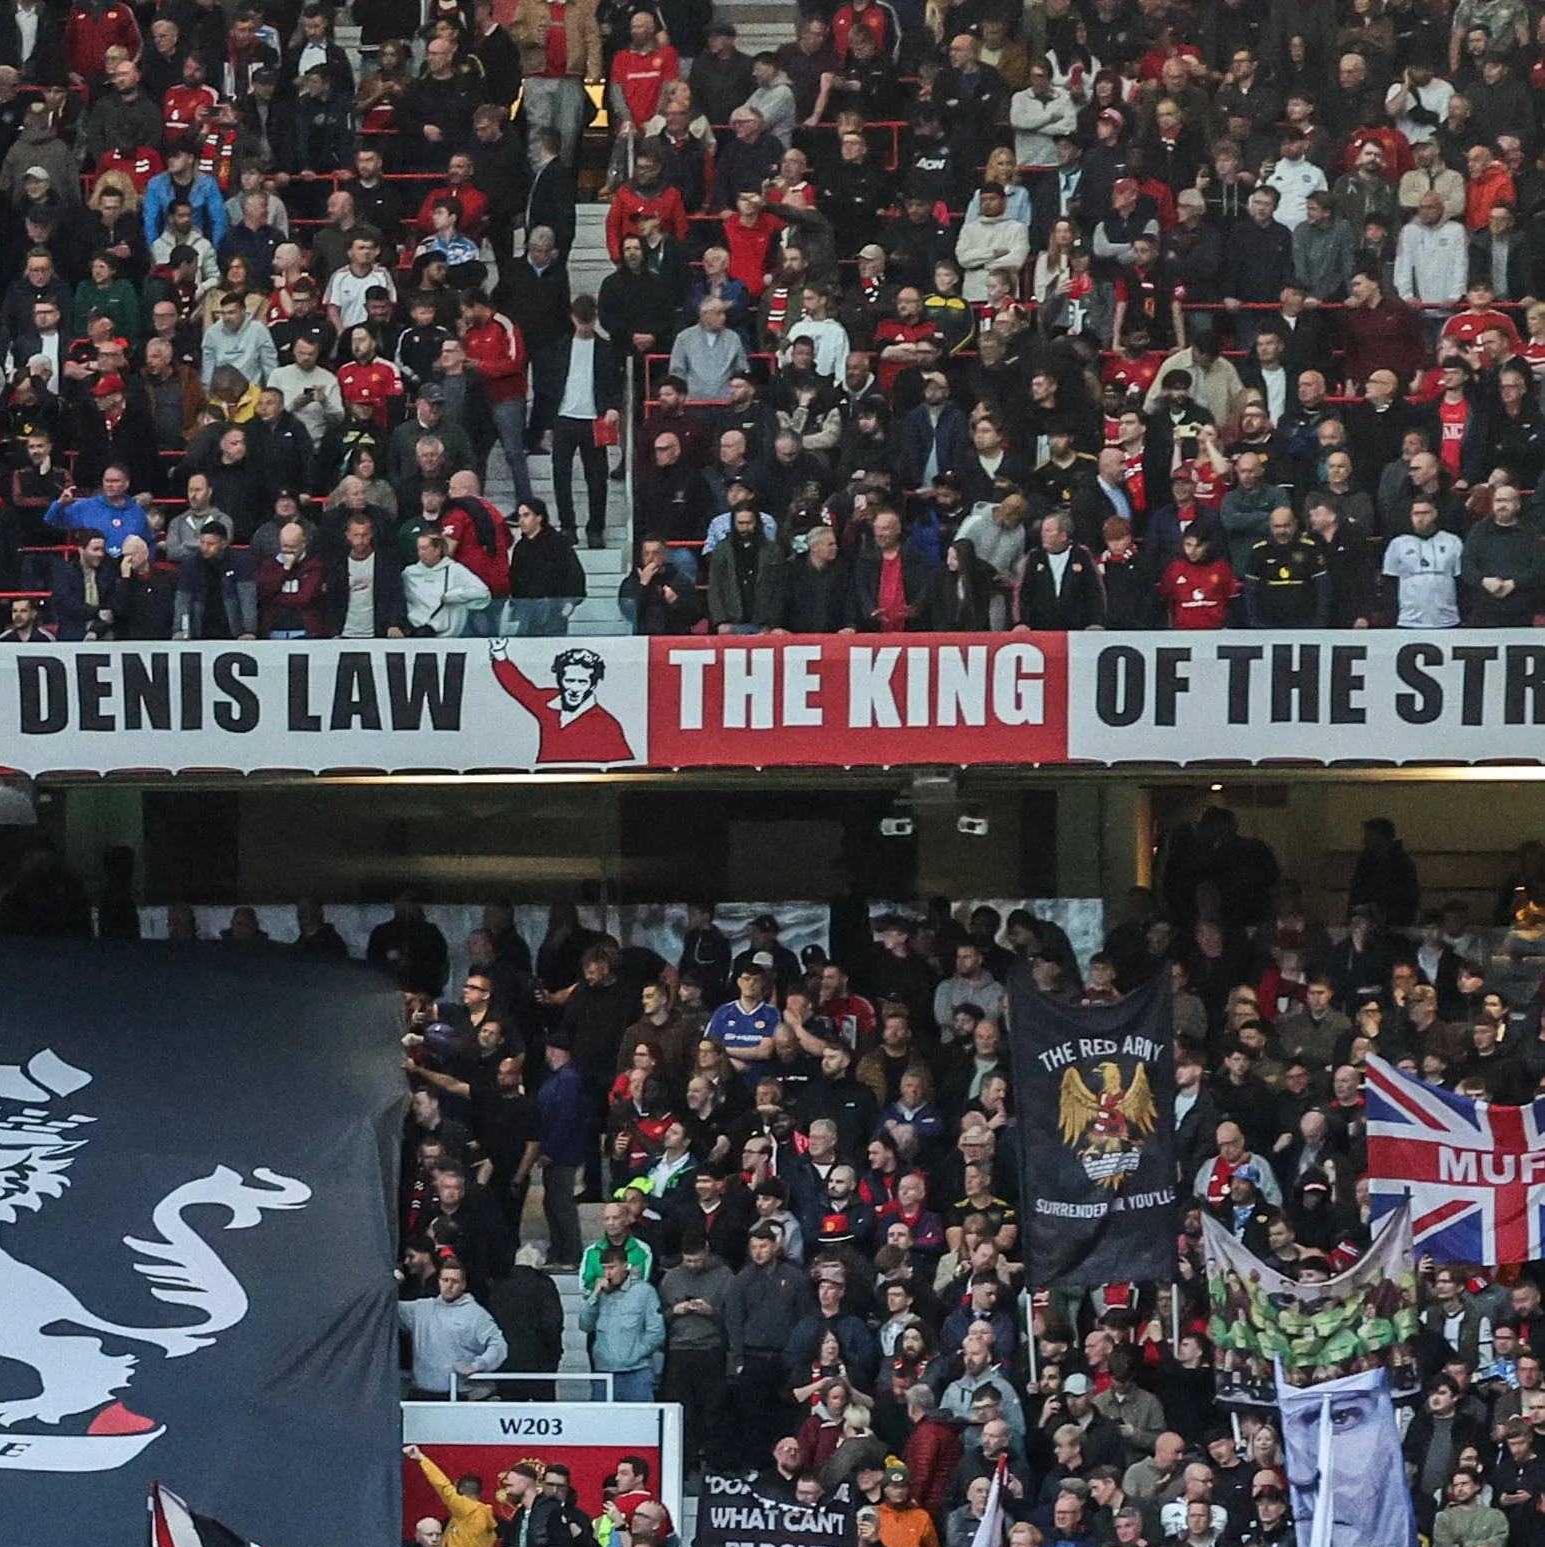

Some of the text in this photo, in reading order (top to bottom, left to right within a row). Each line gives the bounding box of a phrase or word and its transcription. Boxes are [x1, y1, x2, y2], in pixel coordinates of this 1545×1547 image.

[16, 651, 467, 735] DENIS LAW
[668, 642, 1046, 730] THE KING
[1096, 644, 1192, 728] OF
[1216, 643, 1368, 725] THE
[1038, 1035, 1164, 1073] THE RED ARMY
[1035, 1197, 1109, 1219] SURRENDER
[499, 1417, 563, 1436] W203
[710, 1507, 846, 1537] WHAT CAN'T
